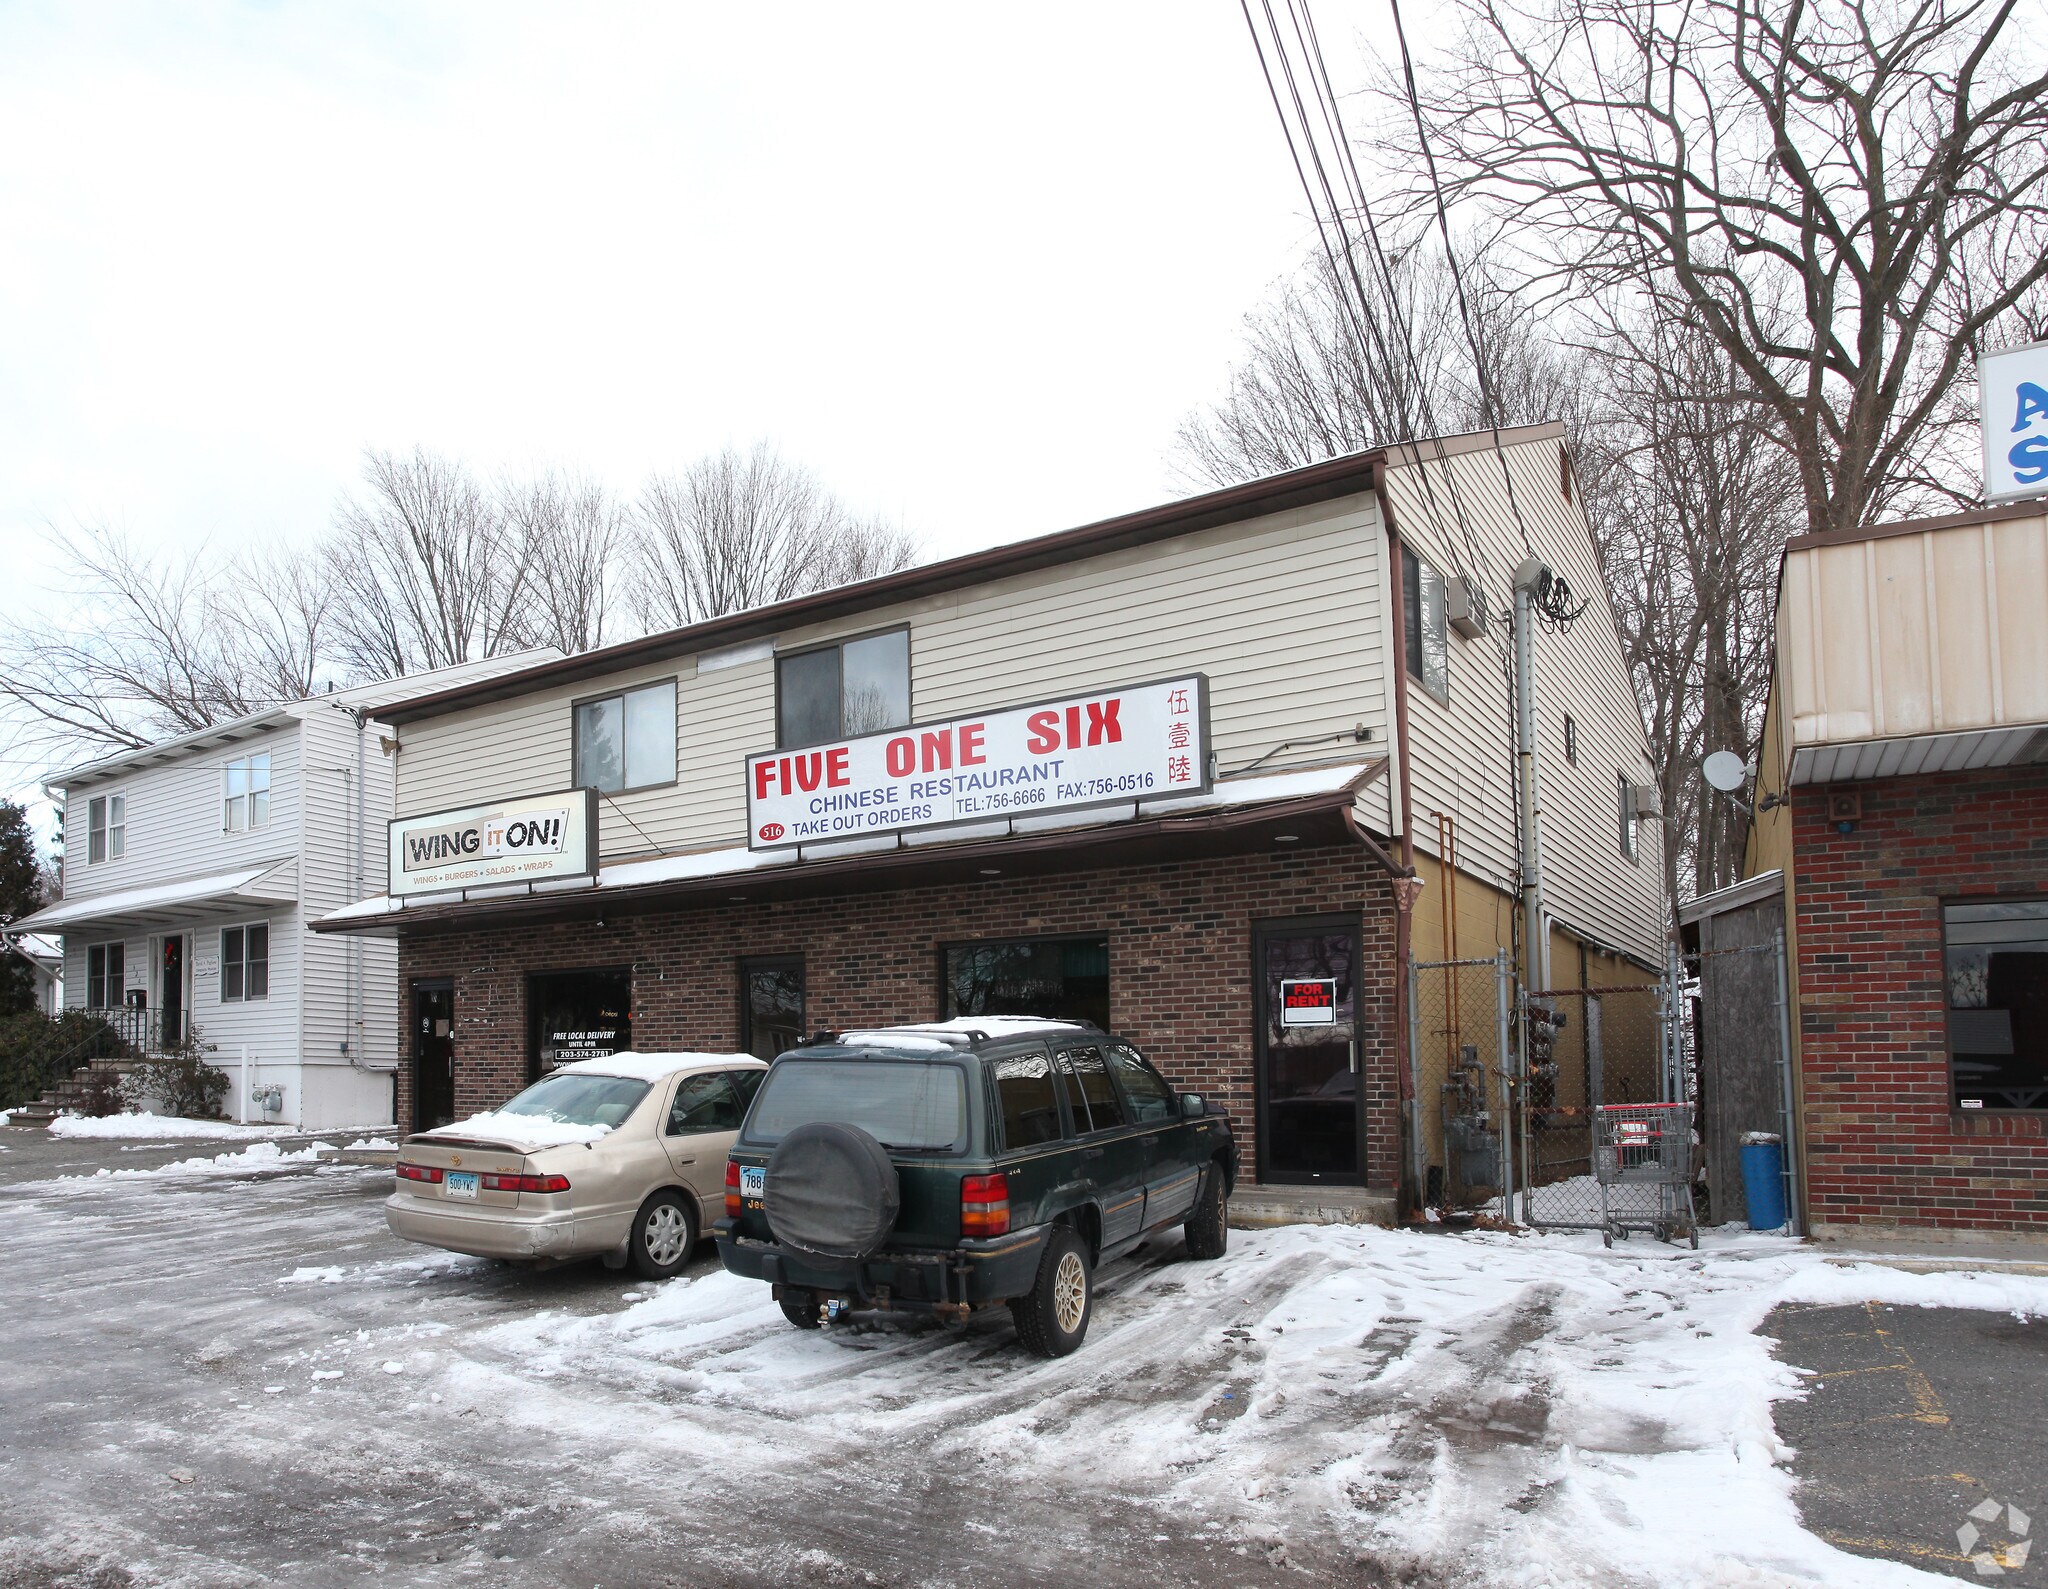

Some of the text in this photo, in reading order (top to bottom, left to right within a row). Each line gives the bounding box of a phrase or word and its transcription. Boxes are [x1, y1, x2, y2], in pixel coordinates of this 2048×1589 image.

[1167, 689, 1191, 784] 伍壹陸
[755, 698, 1122, 800] FIVE ONE SIX
[809, 760, 1064, 815] CHINESE RESTAURANT
[792, 771, 1154, 836] TAKE OUT ORDERS TEL:756-6666 FAX:756-0516
[409, 828, 480, 862] WING
[506, 818, 560, 848] ON!
[763, 825, 782, 838] 516
[413, 860, 553, 885] WINGS BURGERS SALADS WRAPS
[1294, 983, 1323, 995] FOR
[1286, 995, 1331, 1007] RENT
[567, 1031, 586, 1040] LOCAL
[587, 1031, 616, 1039] DELIVERY
[560, 1050, 609, 1058] 203-574-2781
[747, 1200, 765, 1210] Jee
